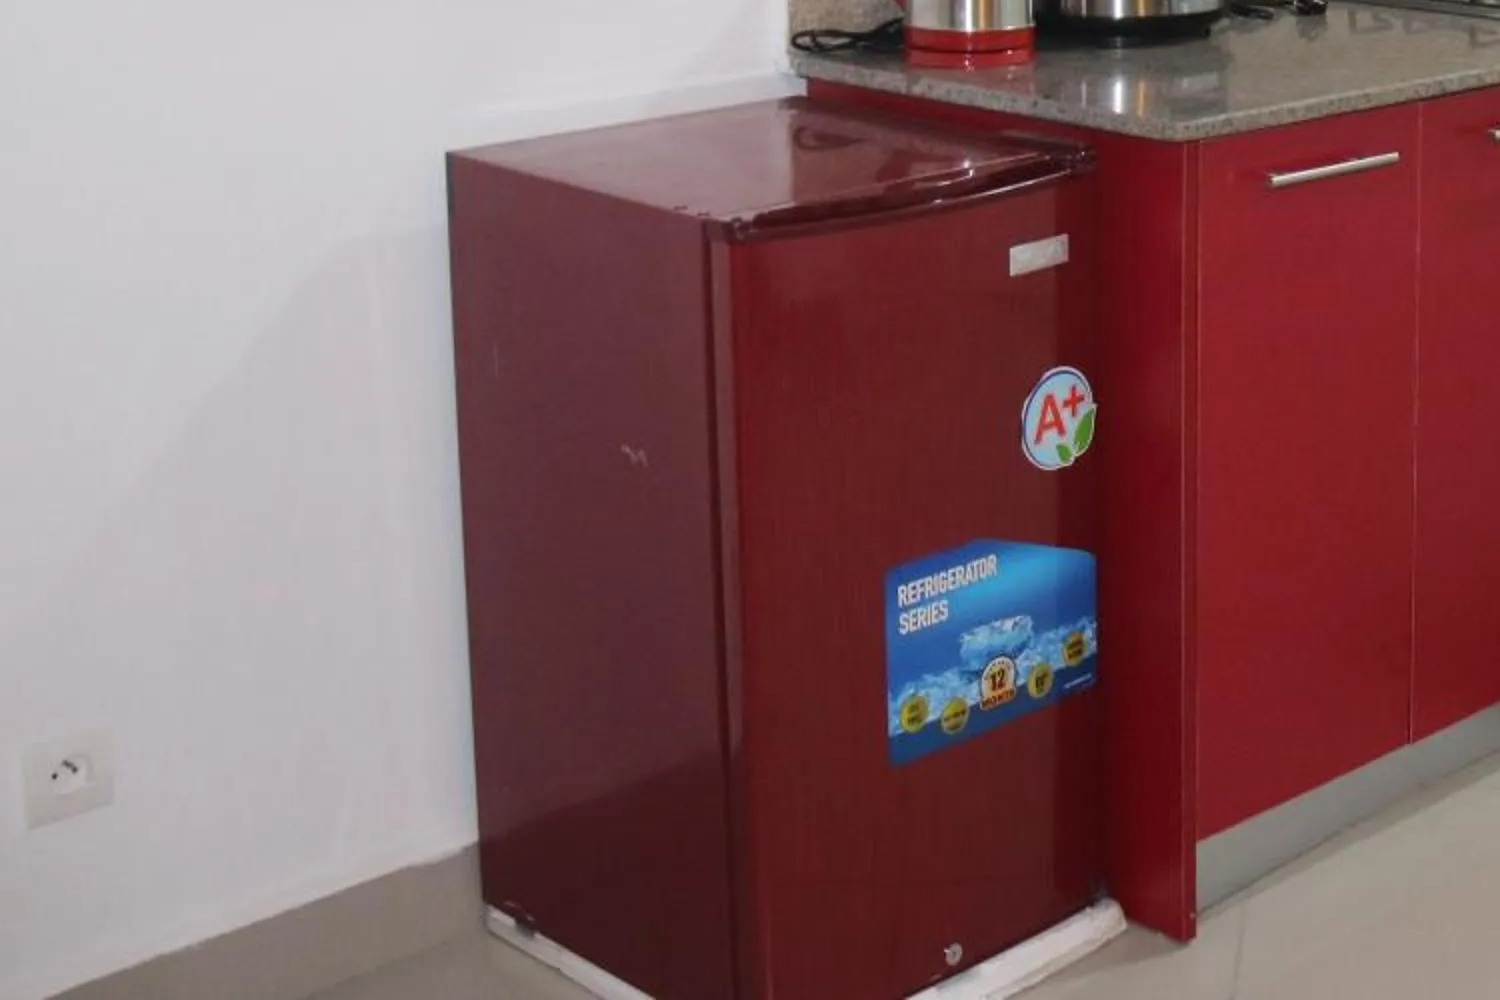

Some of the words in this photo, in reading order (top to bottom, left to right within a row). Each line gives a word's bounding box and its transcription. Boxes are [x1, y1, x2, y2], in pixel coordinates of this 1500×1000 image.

[1034, 384, 1085, 444] A+
[897, 554, 997, 608] REFRIGERATOR
[898, 599, 949, 635] SERIES
[991, 667, 1005, 691] 12
